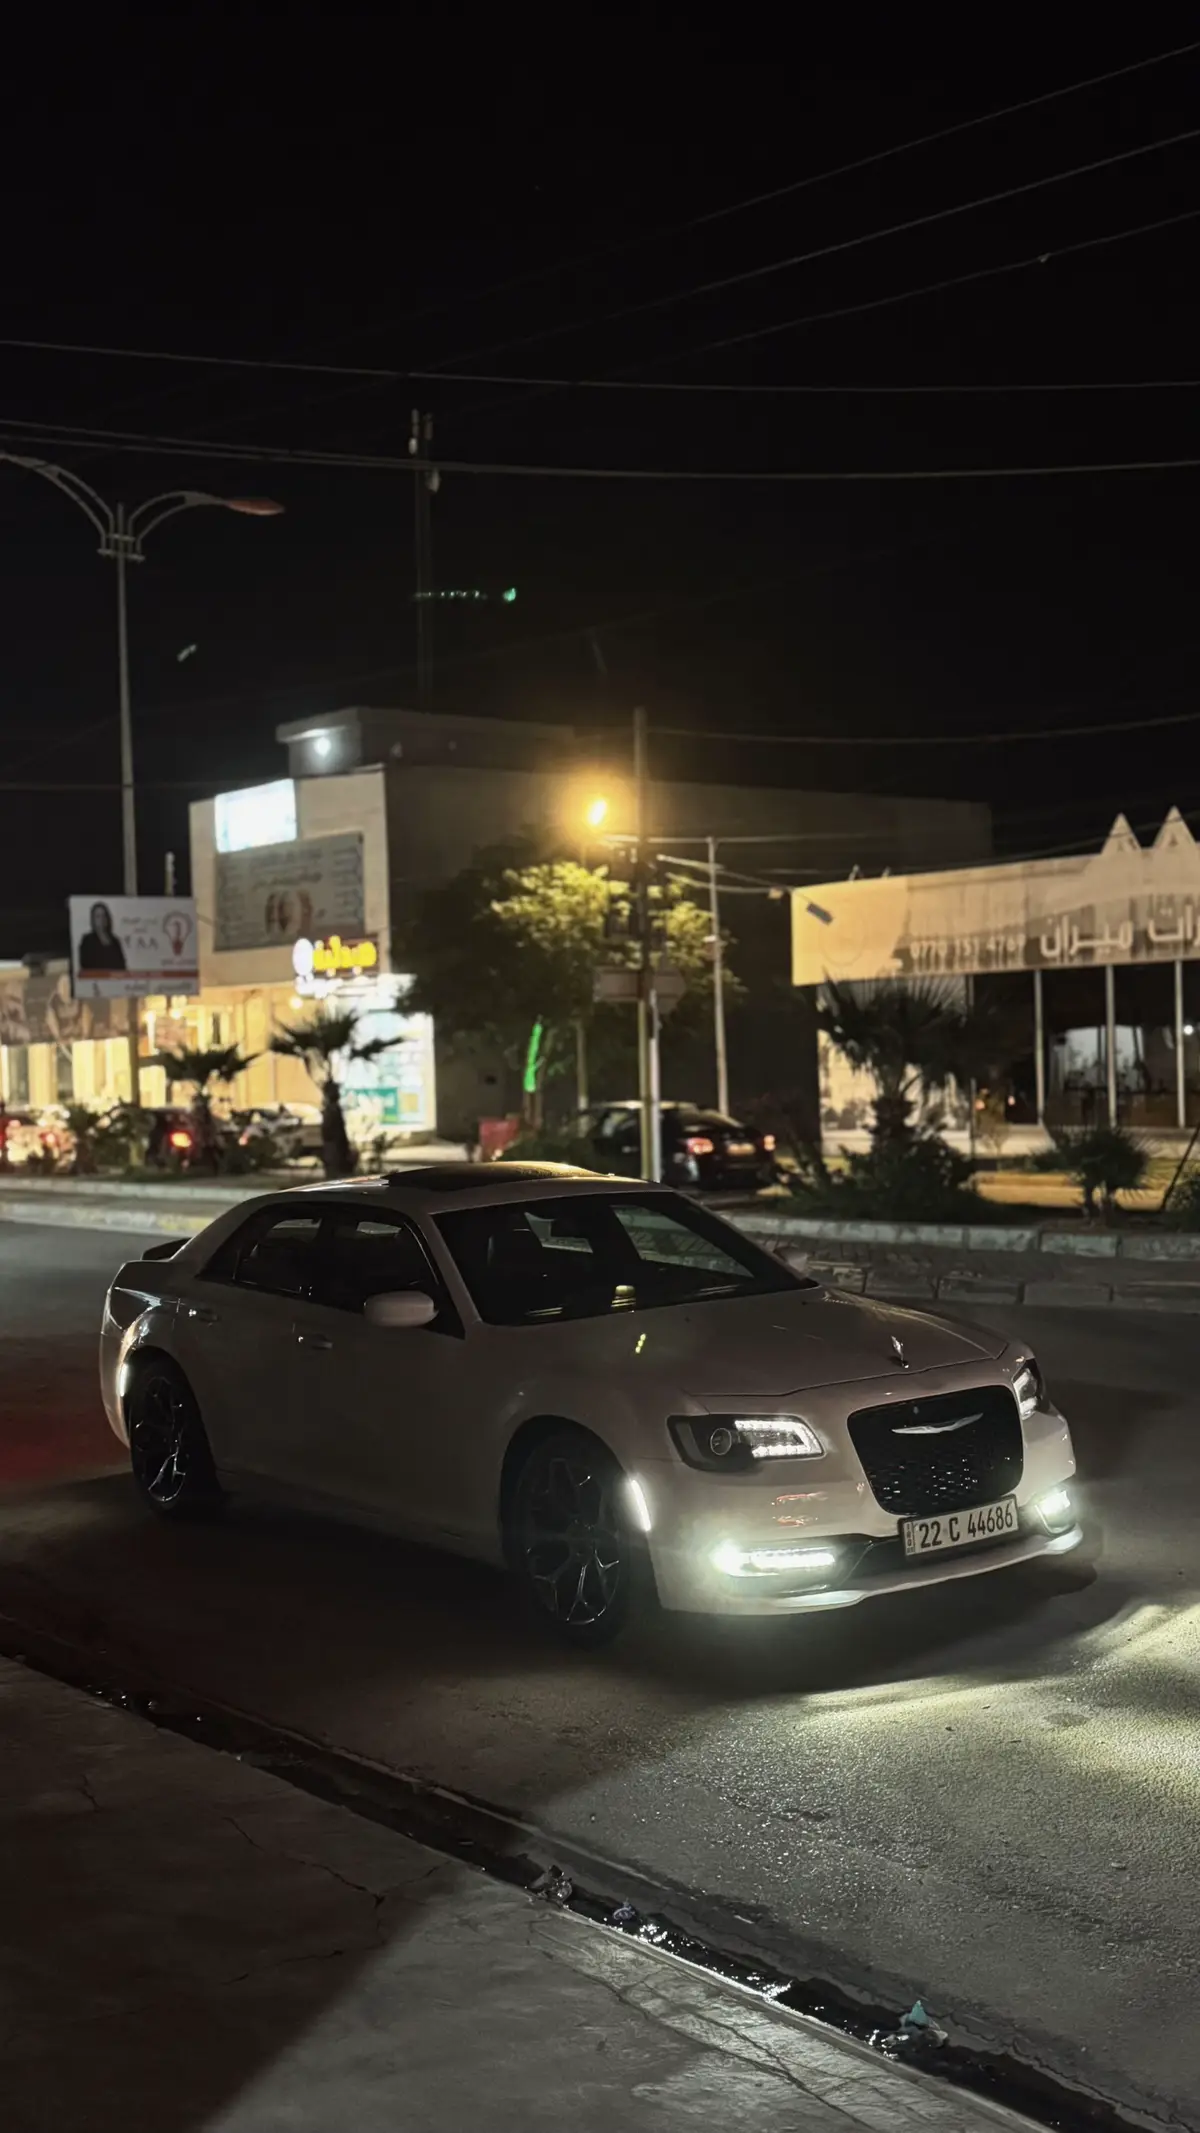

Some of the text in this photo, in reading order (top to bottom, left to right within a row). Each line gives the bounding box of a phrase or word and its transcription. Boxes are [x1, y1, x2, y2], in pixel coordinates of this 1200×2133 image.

[1040, 914, 1134, 958] ميران
[919, 1503, 1013, 1549] 22 C 44686
